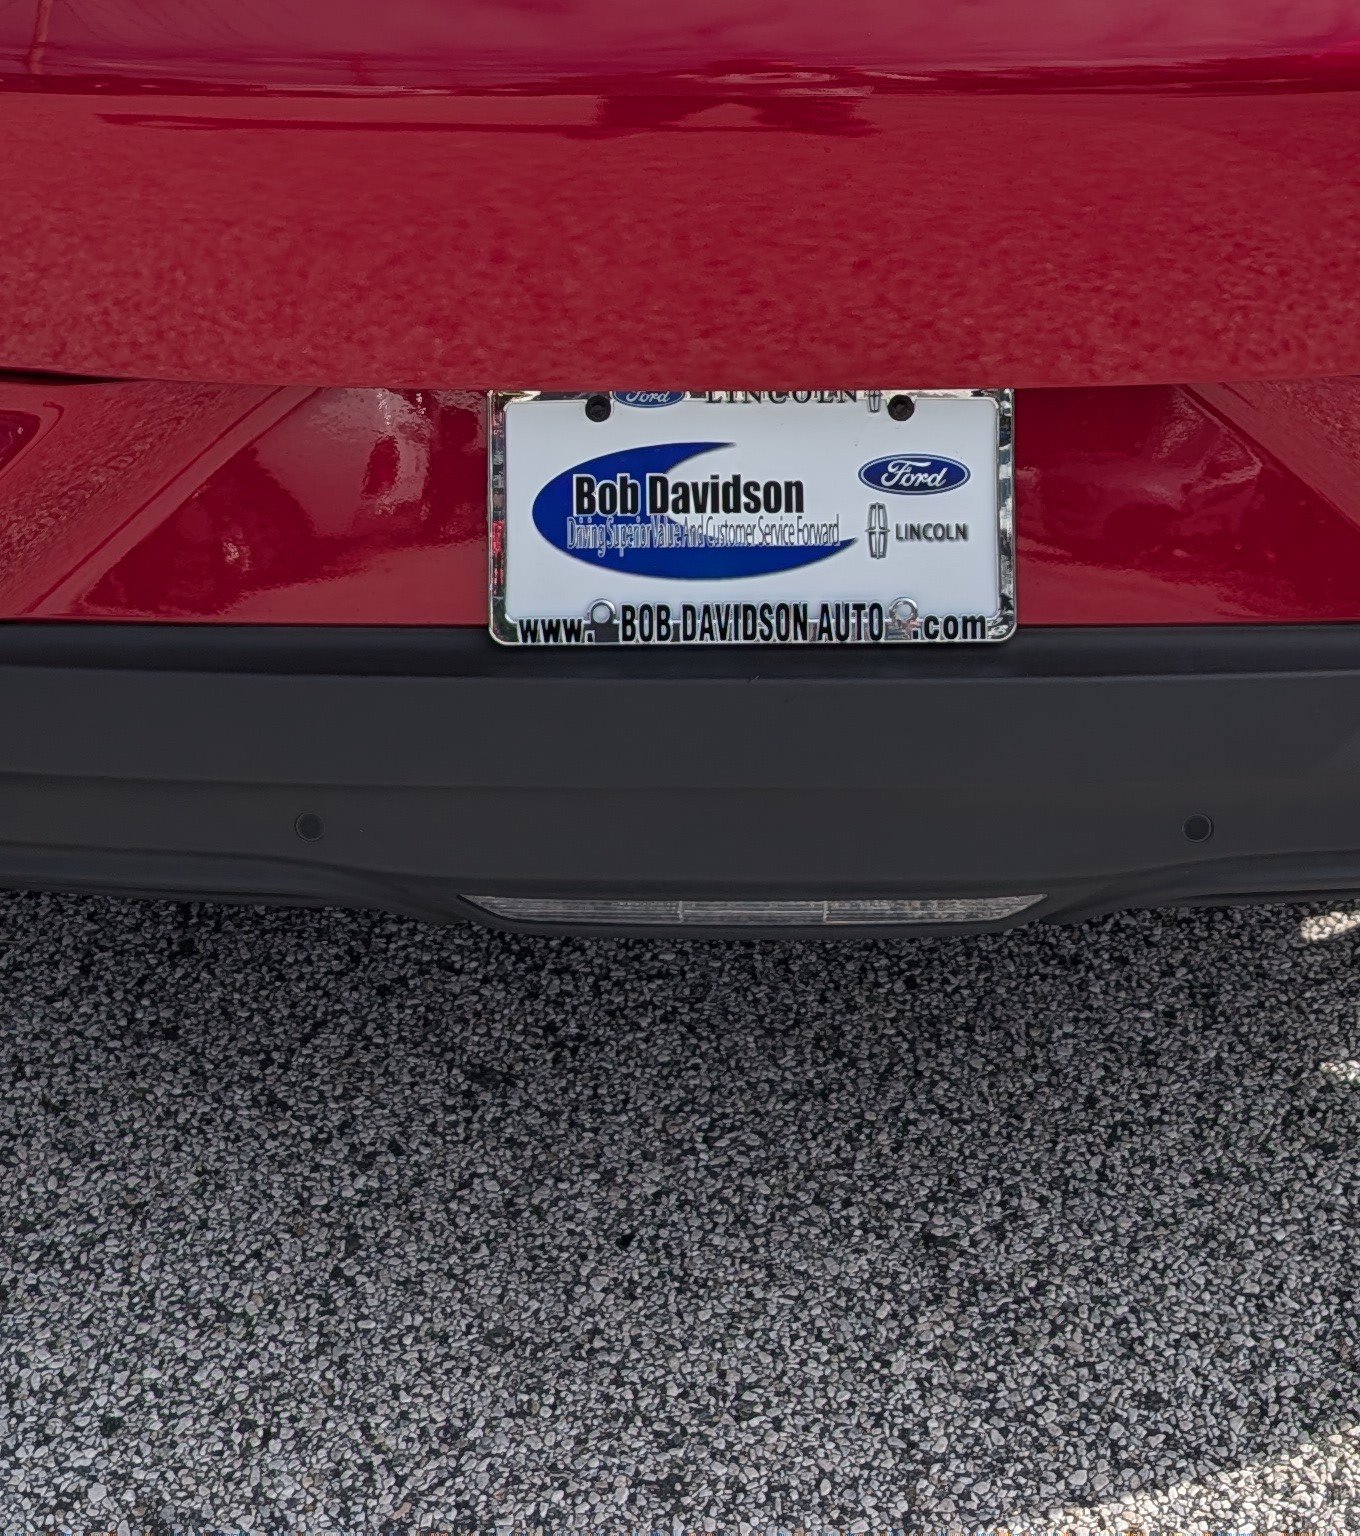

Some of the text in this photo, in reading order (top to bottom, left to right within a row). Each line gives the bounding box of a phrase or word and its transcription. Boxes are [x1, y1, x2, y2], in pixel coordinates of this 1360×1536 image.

[880, 459, 949, 487] Ford
[574, 473, 805, 516] Bob Davidson
[567, 517, 606, 557] Driving
[606, 516, 651, 557] Superior
[651, 515, 682, 548] Value
[705, 516, 757, 547] Customer
[757, 516, 795, 546] Service
[796, 514, 840, 546] Forward
[895, 523, 969, 542] LINCOLN
[621, 603, 671, 642] BOB
[681, 602, 808, 642] DAVIDSON
[817, 602, 884, 641] AUTO
